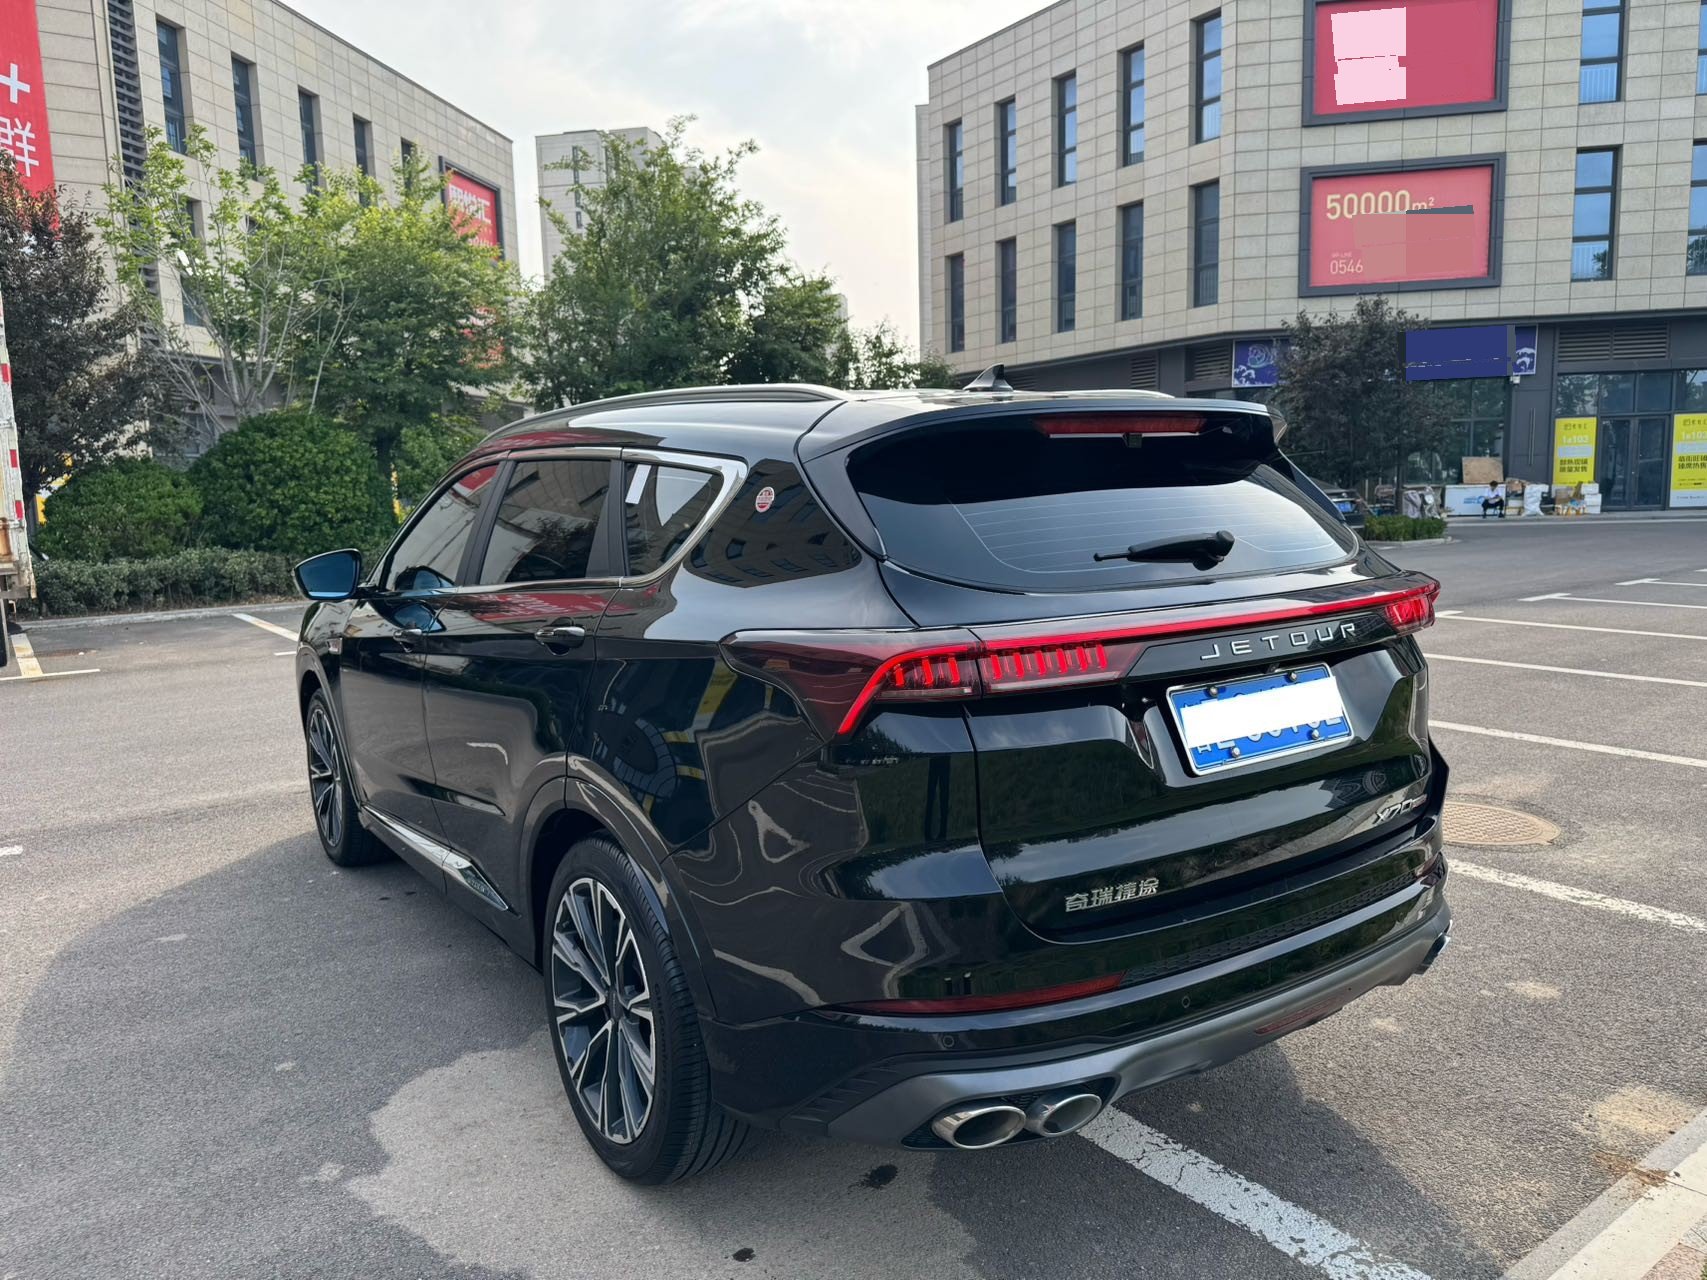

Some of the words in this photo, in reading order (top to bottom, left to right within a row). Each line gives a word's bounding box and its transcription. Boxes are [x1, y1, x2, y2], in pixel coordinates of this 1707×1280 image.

[1330, 258, 1364, 275] 0546
[1200, 622, 1355, 661] JETOUR
[1065, 877, 1160, 912] 奇瑞捷途
